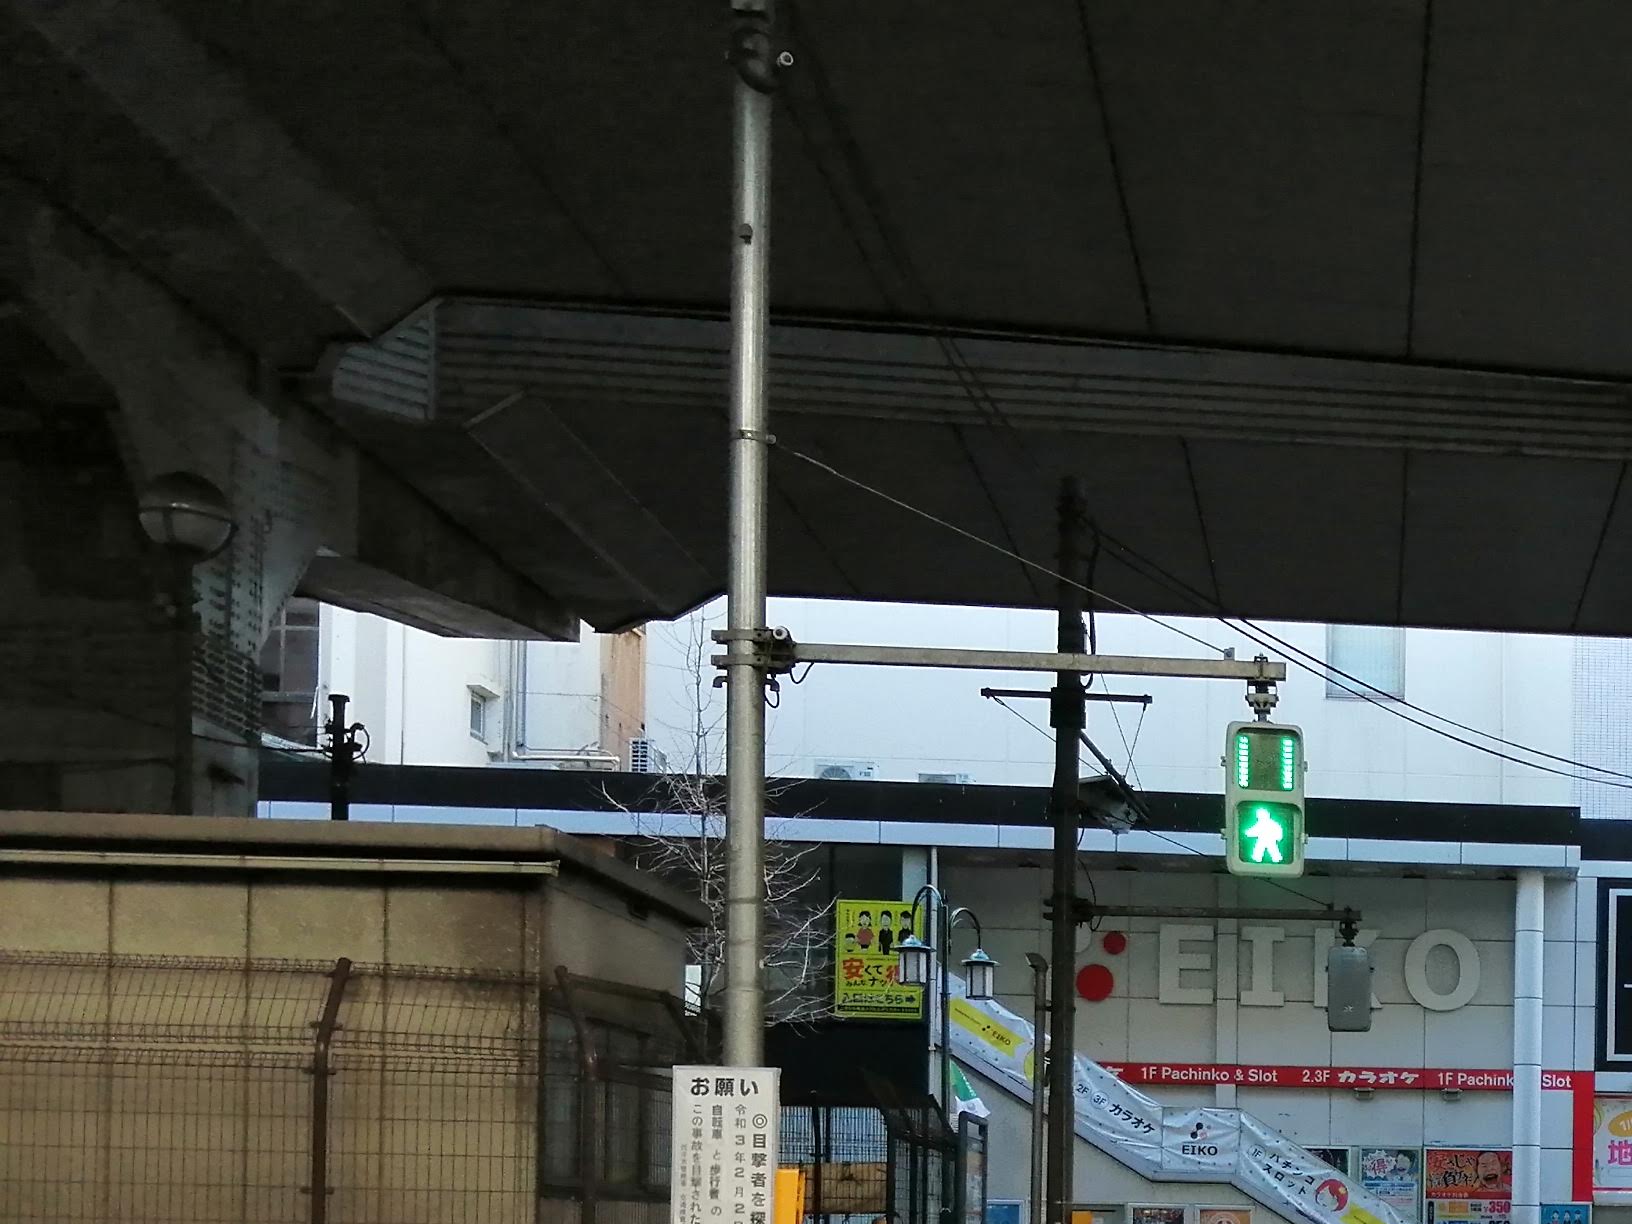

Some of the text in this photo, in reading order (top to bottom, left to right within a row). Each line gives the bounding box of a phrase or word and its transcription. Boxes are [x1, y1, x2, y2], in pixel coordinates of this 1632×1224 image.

[992, 1030, 1012, 1046] EIKO
[1141, 1066, 1278, 1082] 1F Pachinko & Slot
[1302, 1069, 1419, 1085] 2.3F カラオケ
[1437, 1072, 1454, 1086] 1F
[1542, 1074, 1572, 1088] Slot
[690, 1077, 759, 1097] お願い
[1076, 1083, 1090, 1095] 2F
[1093, 1094, 1106, 1106] 3F
[1108, 1102, 1156, 1134] カラオケ
[1182, 1144, 1218, 1156] EIKO
[1251, 1148, 1263, 1159] 1F
[1262, 1163, 1308, 1196] スロット
